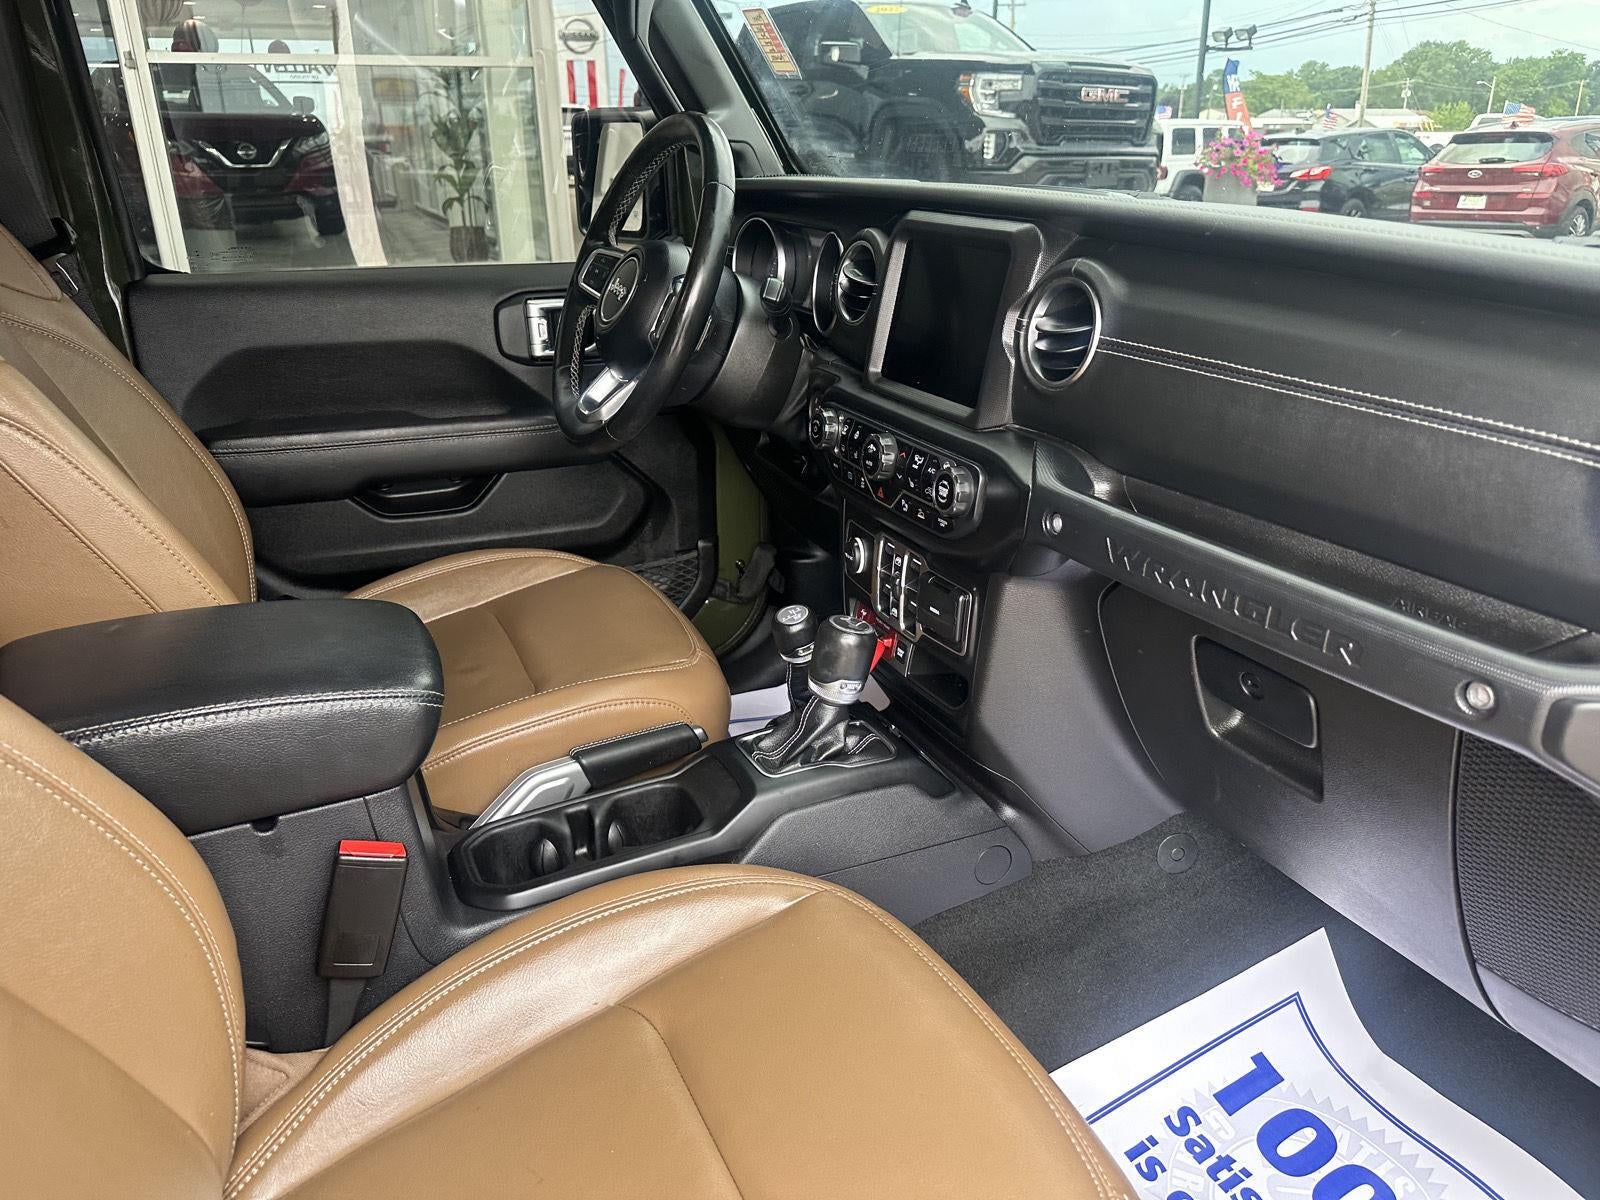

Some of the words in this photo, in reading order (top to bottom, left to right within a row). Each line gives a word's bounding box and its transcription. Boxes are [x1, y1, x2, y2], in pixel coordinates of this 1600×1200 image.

[560, 30, 600, 41] NISSAN
[1081, 86, 1130, 104] GMC
[610, 277, 628, 301] Jeep
[1105, 536, 1367, 667] WRANGLER
[1123, 1134, 1168, 1182] is
